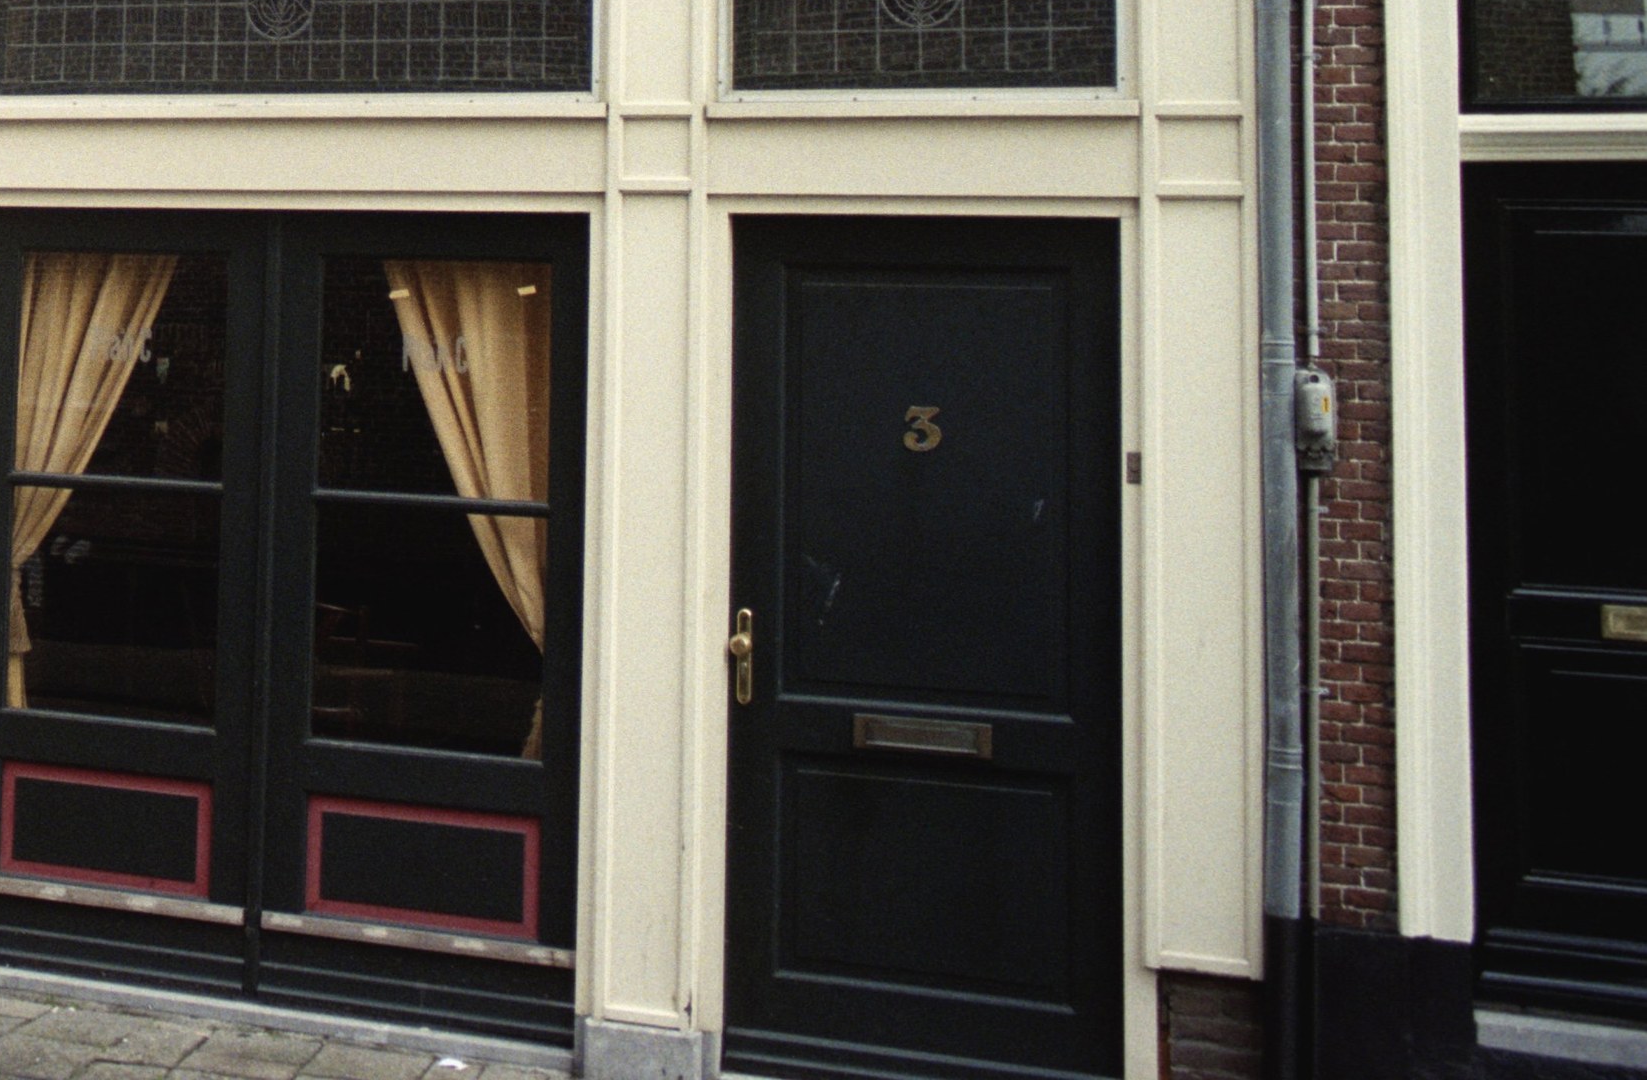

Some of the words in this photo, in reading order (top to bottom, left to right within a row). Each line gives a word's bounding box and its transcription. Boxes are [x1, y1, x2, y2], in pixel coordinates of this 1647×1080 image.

[140, 327, 153, 363] C
[455, 335, 468, 374] C
[903, 406, 942, 452] 3
